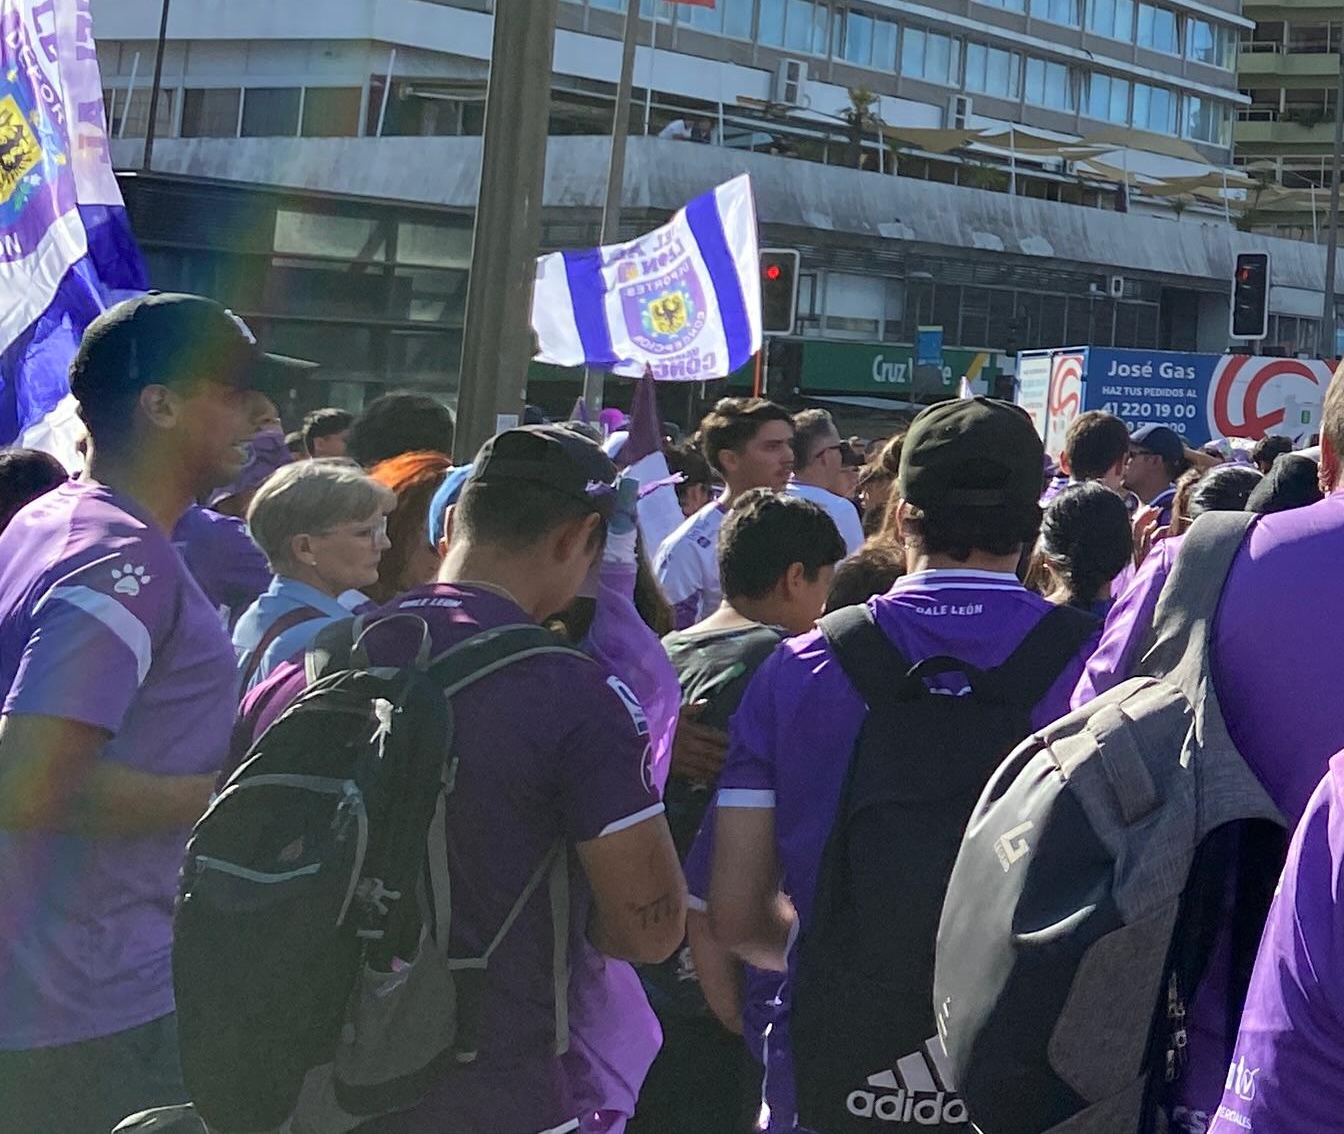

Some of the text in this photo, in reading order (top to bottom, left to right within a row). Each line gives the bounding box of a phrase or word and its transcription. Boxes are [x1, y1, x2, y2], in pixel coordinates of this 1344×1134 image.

[872, 354, 906, 382] Cruz
[1107, 360, 1196, 379] José Gas
[1102, 386, 1197, 397] HAZ TUS PEDIDOS AL
[1121, 402, 1151, 417] 220
[1155, 403, 1171, 418] 19
[1174, 404, 1196, 418] 00
[846, 1088, 969, 1125] adida
